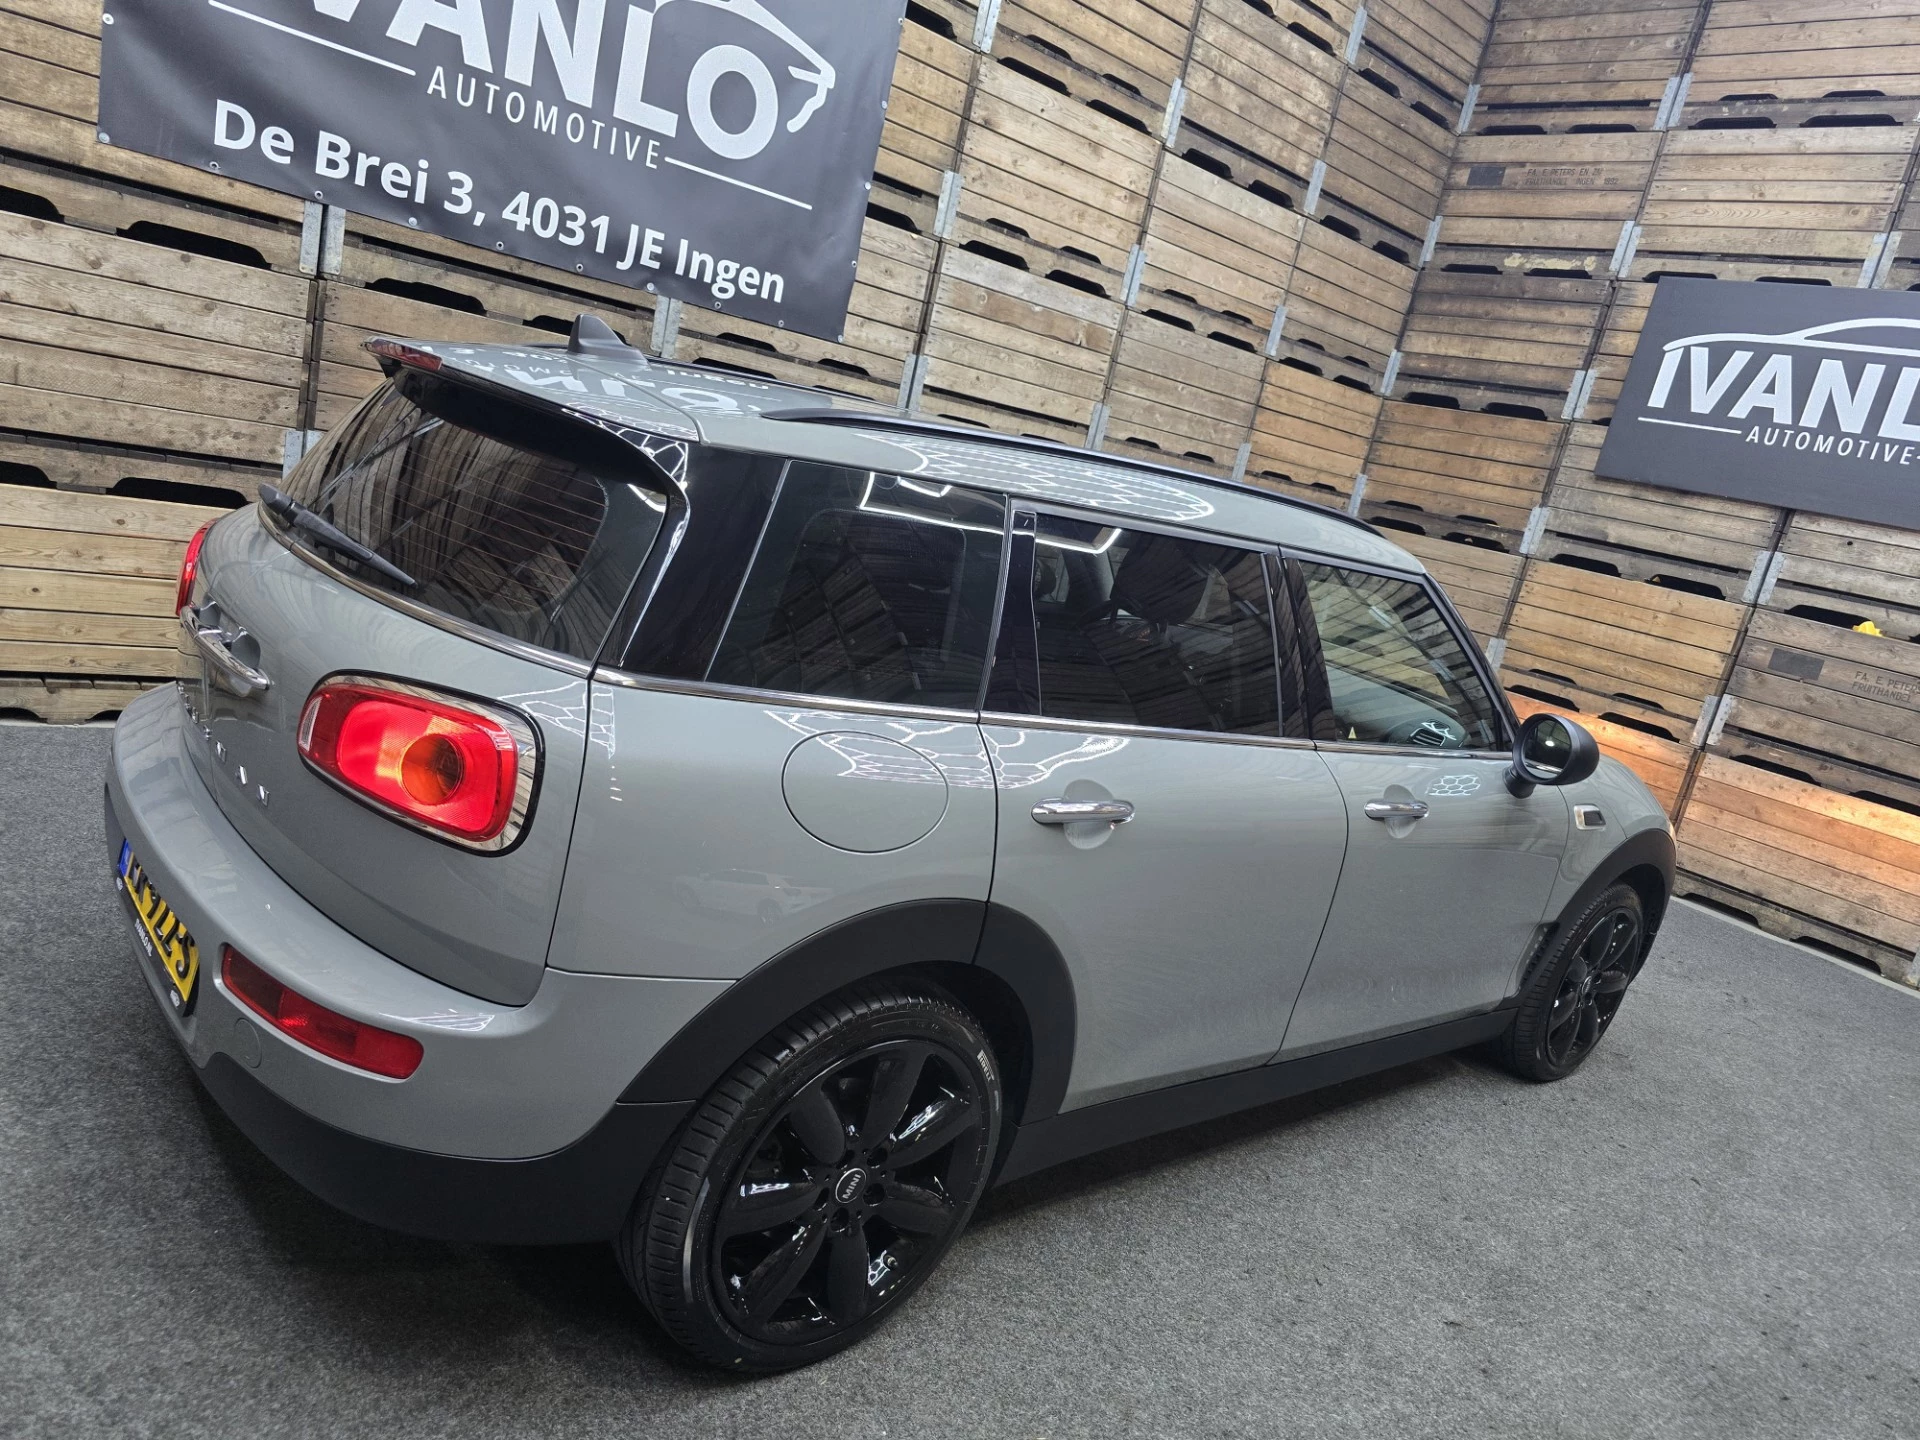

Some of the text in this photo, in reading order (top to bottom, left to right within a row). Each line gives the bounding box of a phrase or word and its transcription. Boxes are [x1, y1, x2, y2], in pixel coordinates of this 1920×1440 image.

[426, 65, 661, 170] AUTOMOTIVE
[213, 99, 785, 304] De Brei 3, 4031 JE Ingen
[1647, 346, 1920, 442] IVANL
[1745, 424, 1915, 465] AUTOMOTIVE
[841, 1173, 862, 1200] MINI
